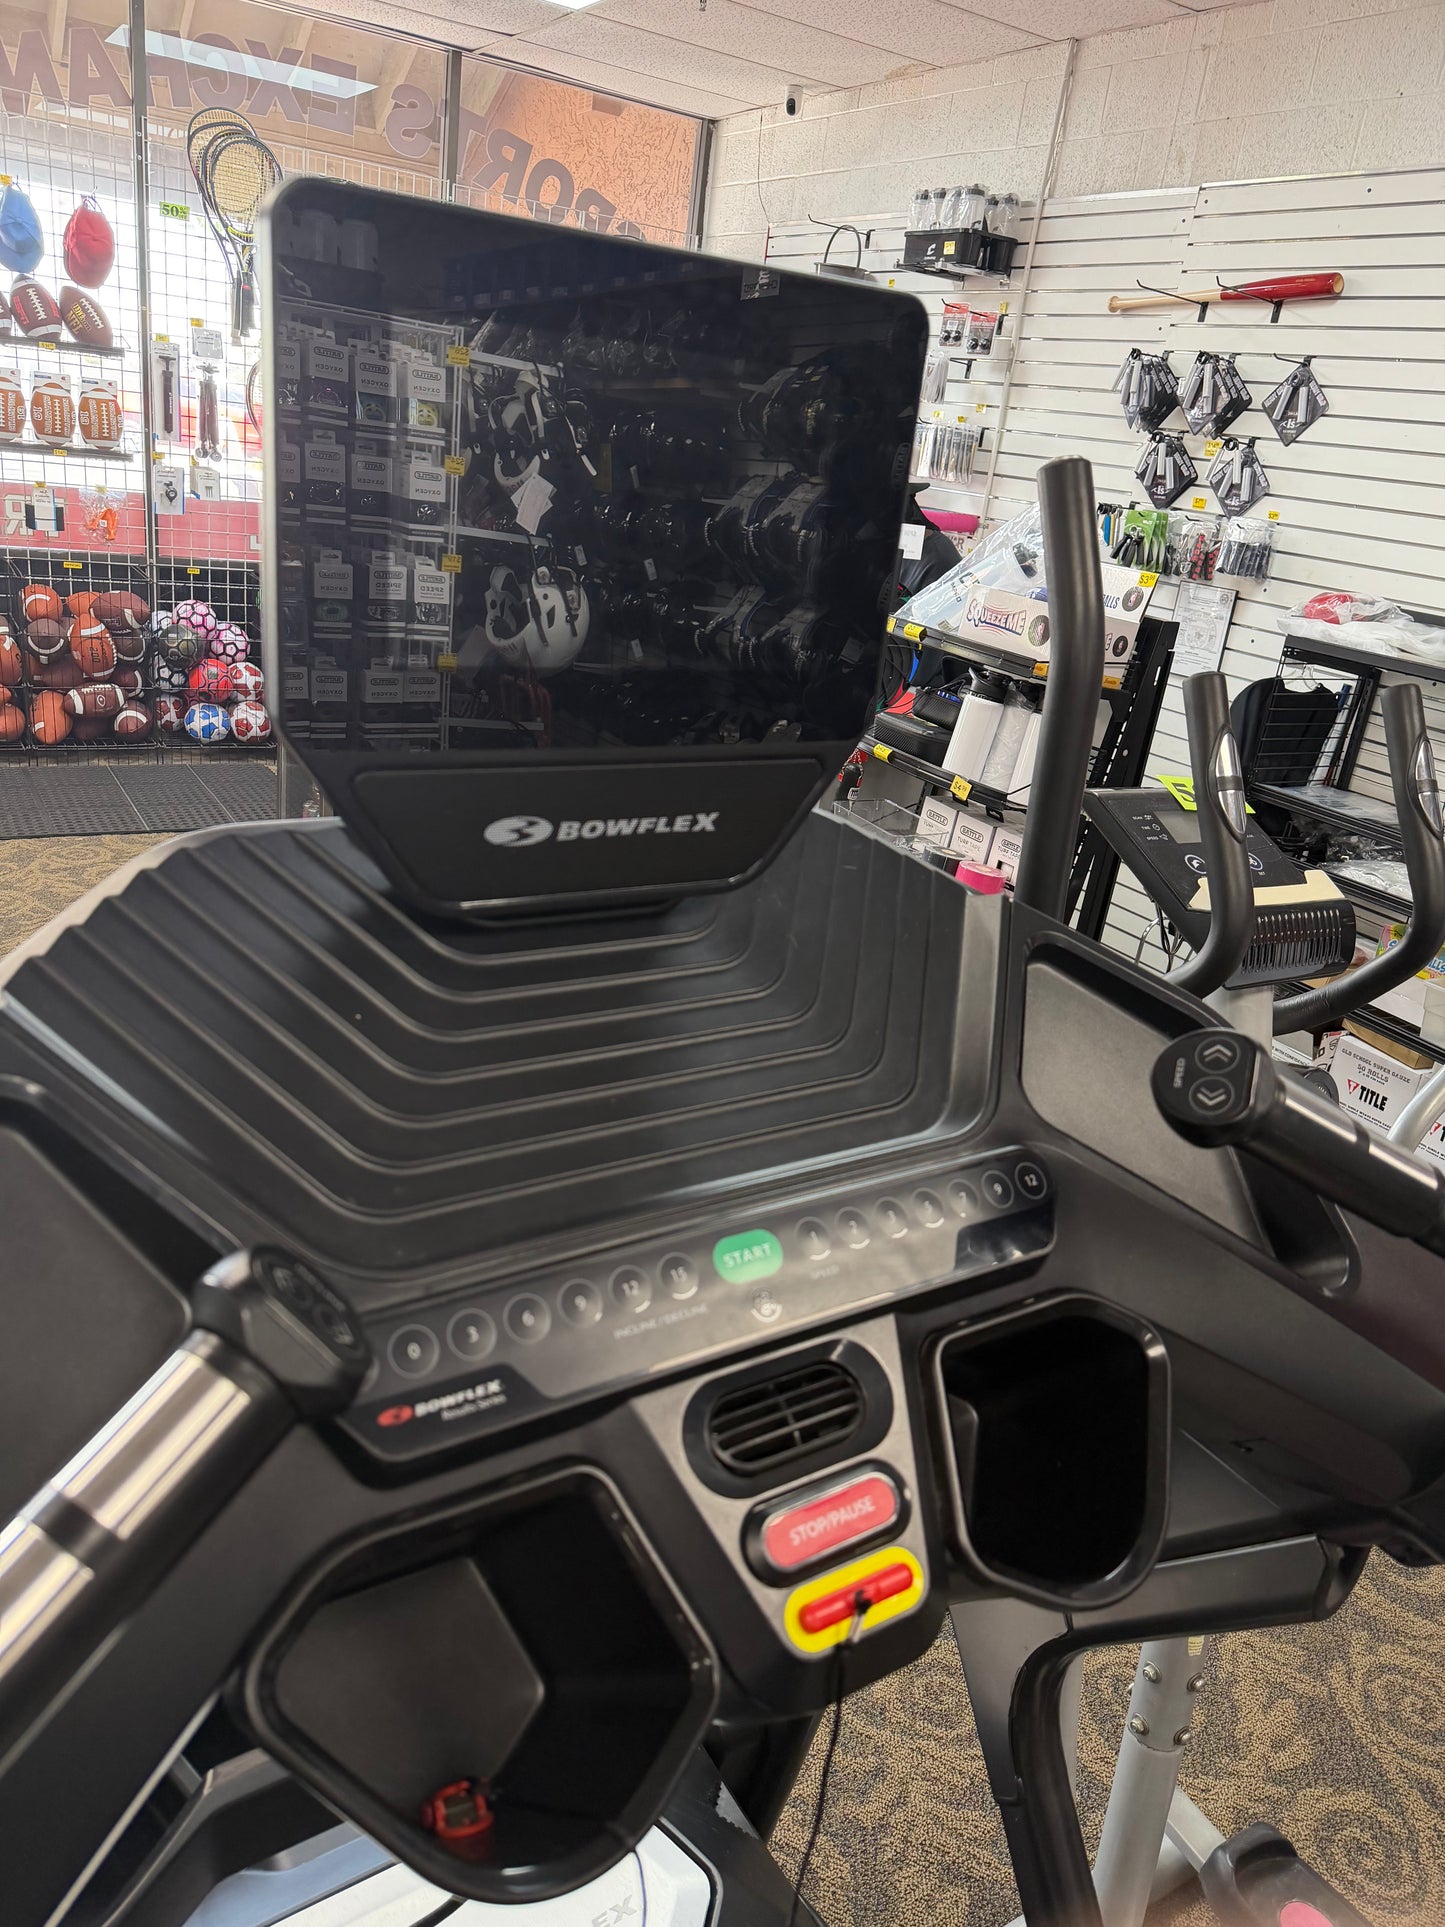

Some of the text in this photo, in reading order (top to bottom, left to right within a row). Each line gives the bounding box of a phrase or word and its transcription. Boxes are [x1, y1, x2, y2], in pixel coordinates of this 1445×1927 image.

[65, 311, 84, 335] NFL
[556, 811, 720, 842] BOWFLEX
[928, 811, 947, 825] BATTLE
[961, 827, 982, 842] BATTLE
[1002, 840, 1020, 852] BATTLE
[1173, 1057, 1186, 1089] SPEED
[1367, 1068, 1389, 1083] ROLLS
[1373, 1062, 1391, 1074] SUPER
[1391, 1071, 1411, 1084] GAUZE
[1359, 1085, 1388, 1111] TITLE
[723, 1242, 772, 1268] START
[669, 1266, 687, 1283] 15
[415, 1379, 502, 1418] BOWFLEX
[789, 1495, 877, 1547] STOP/PAUSE
